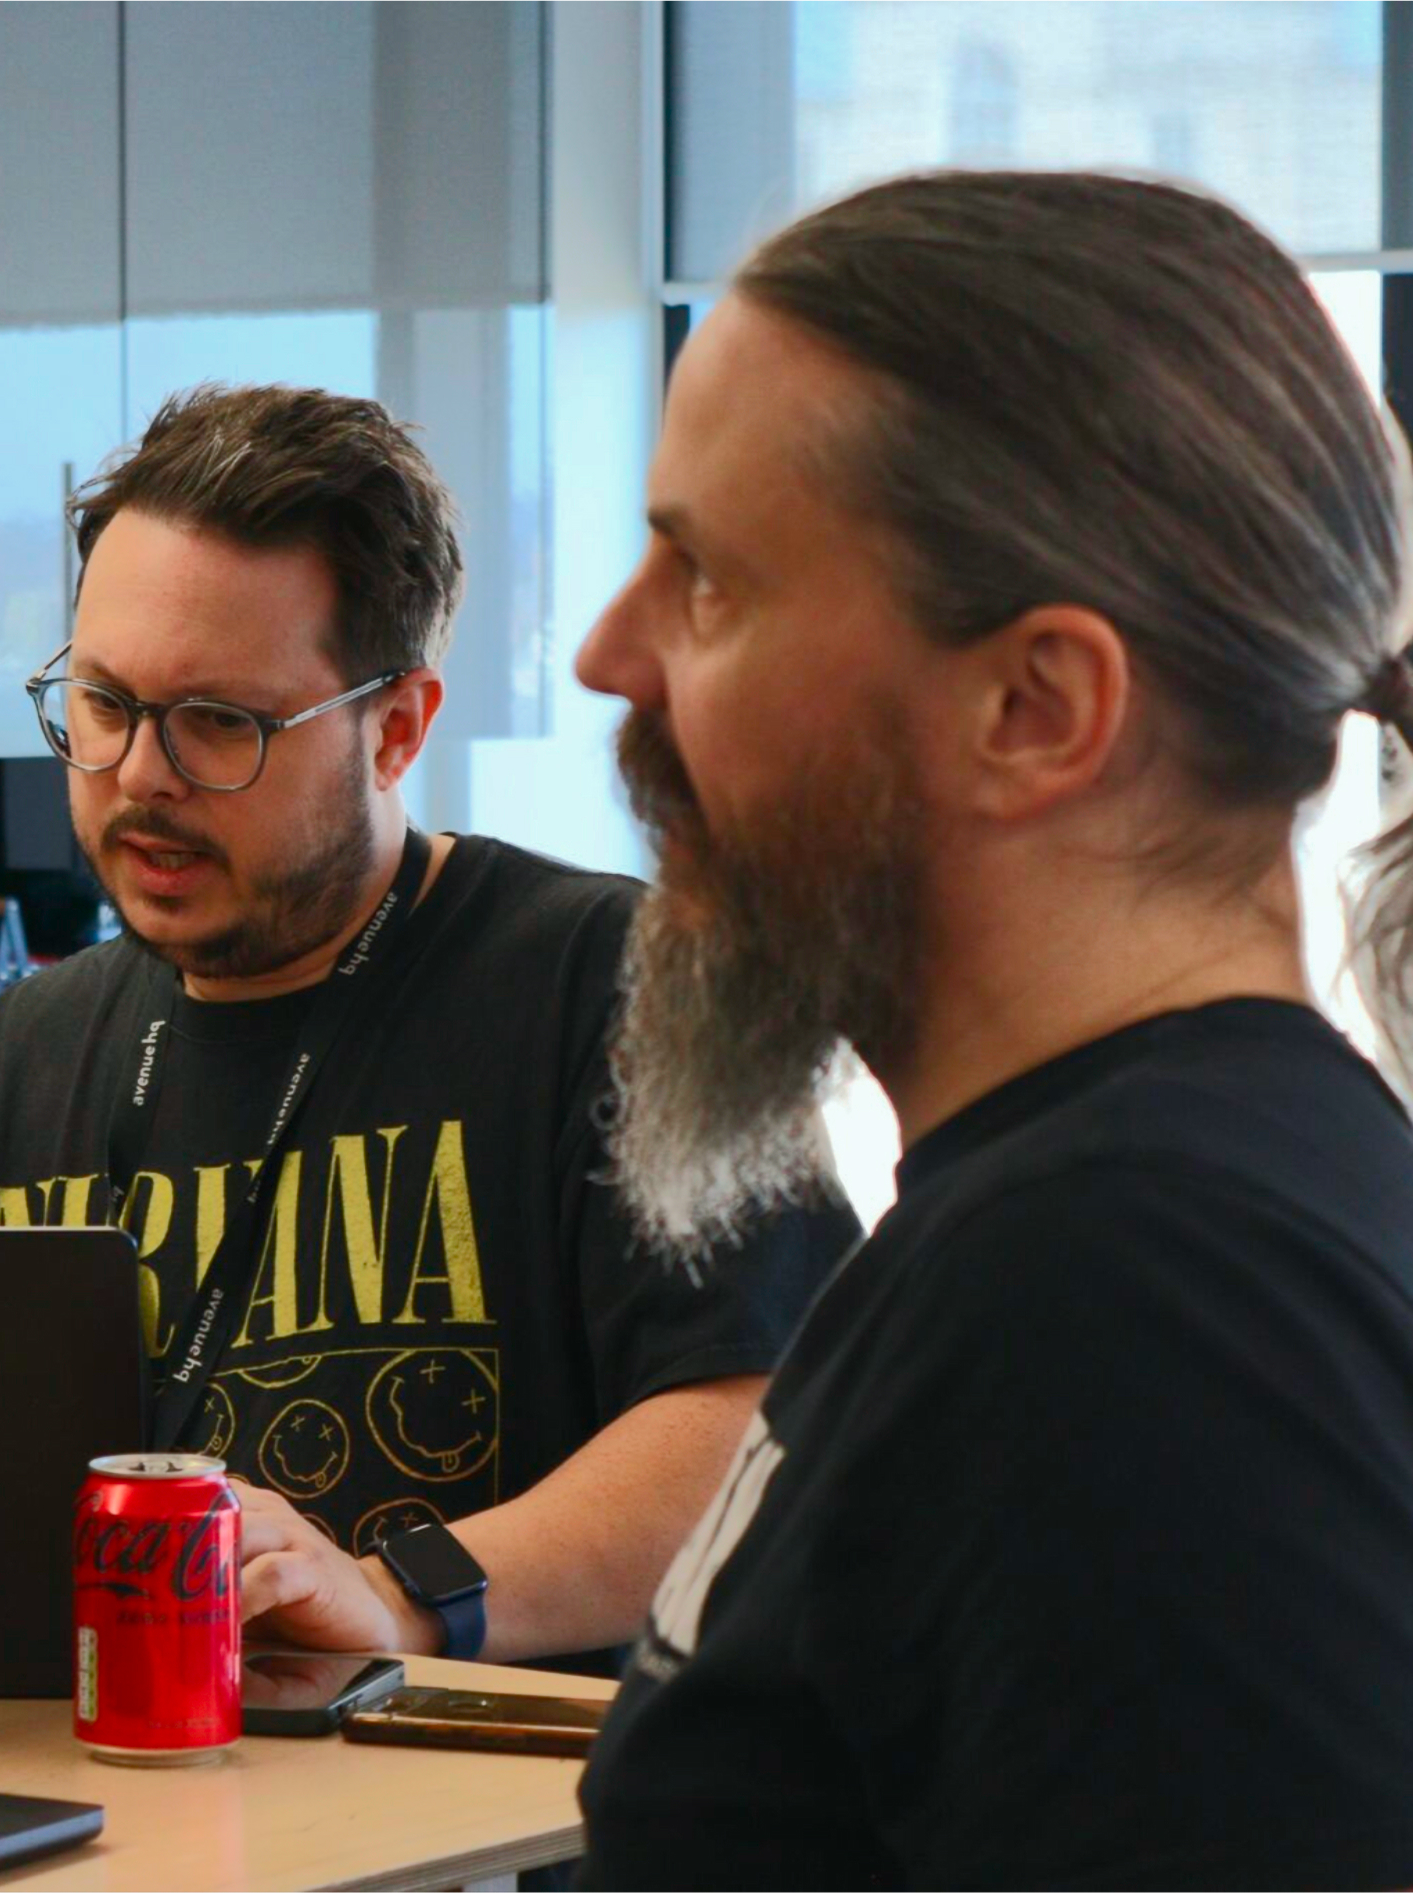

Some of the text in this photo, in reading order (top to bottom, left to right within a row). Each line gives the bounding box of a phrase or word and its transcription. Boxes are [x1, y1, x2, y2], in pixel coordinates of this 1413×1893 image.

[338, 891, 398, 976] avenuehq
[131, 1019, 166, 1107] avenuehq
[172, 1287, 224, 1383] avenuehq
